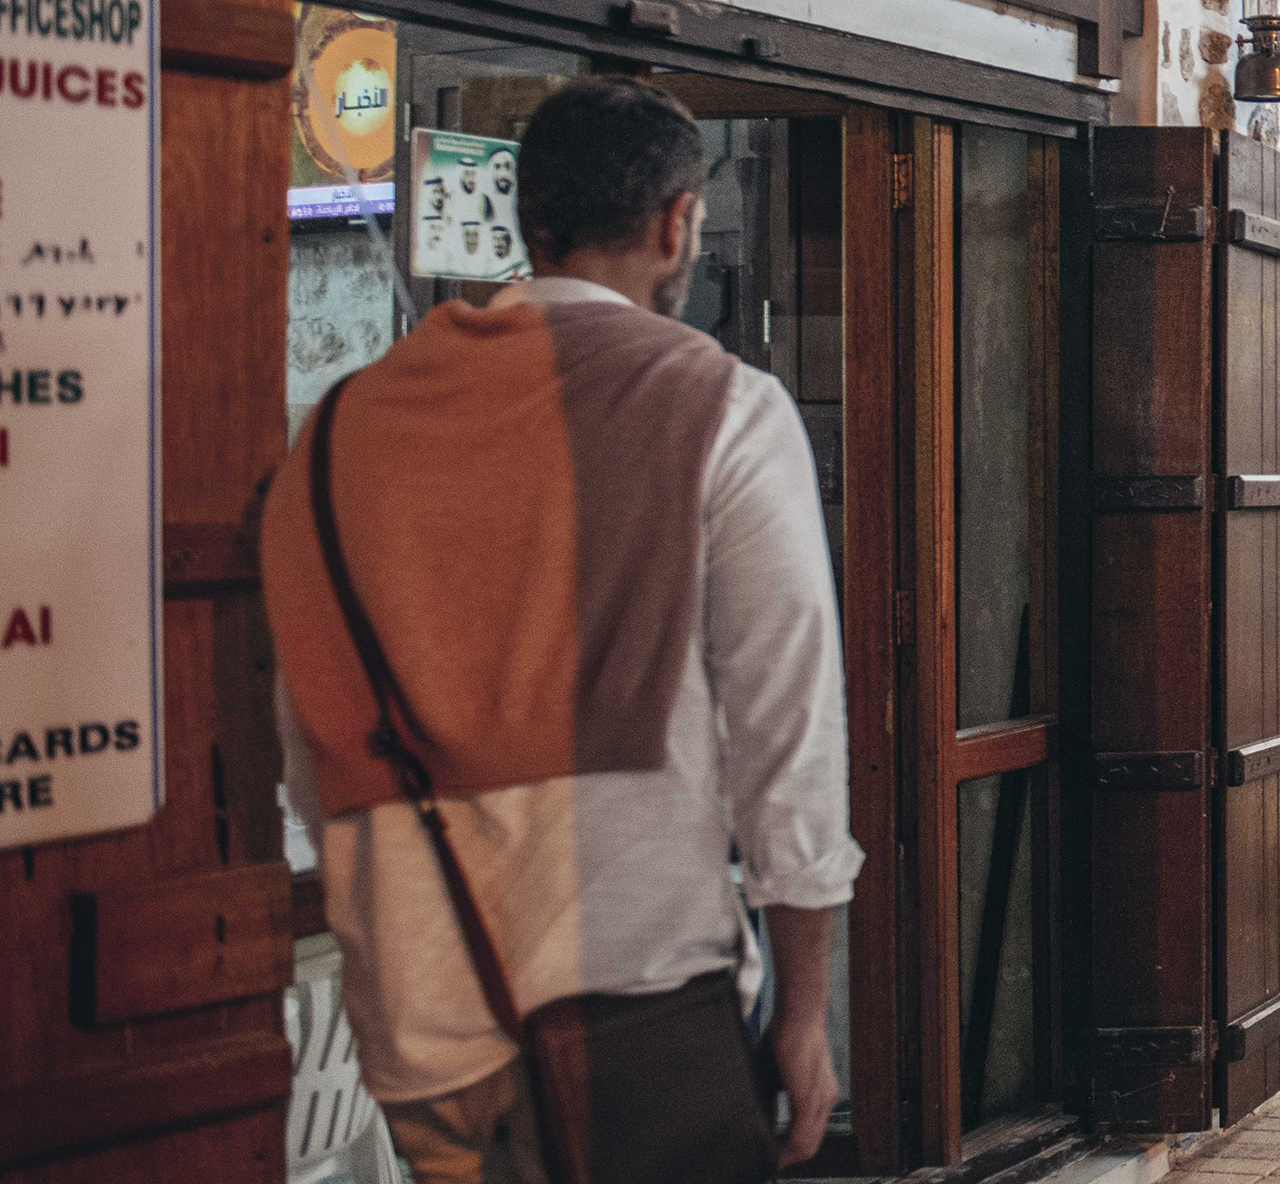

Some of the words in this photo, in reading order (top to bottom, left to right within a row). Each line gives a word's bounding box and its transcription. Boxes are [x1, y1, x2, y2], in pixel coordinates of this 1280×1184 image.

[0, 60, 145, 109] UICES
[0, 369, 84, 405] HES
[0, 719, 141, 765] ARDS
